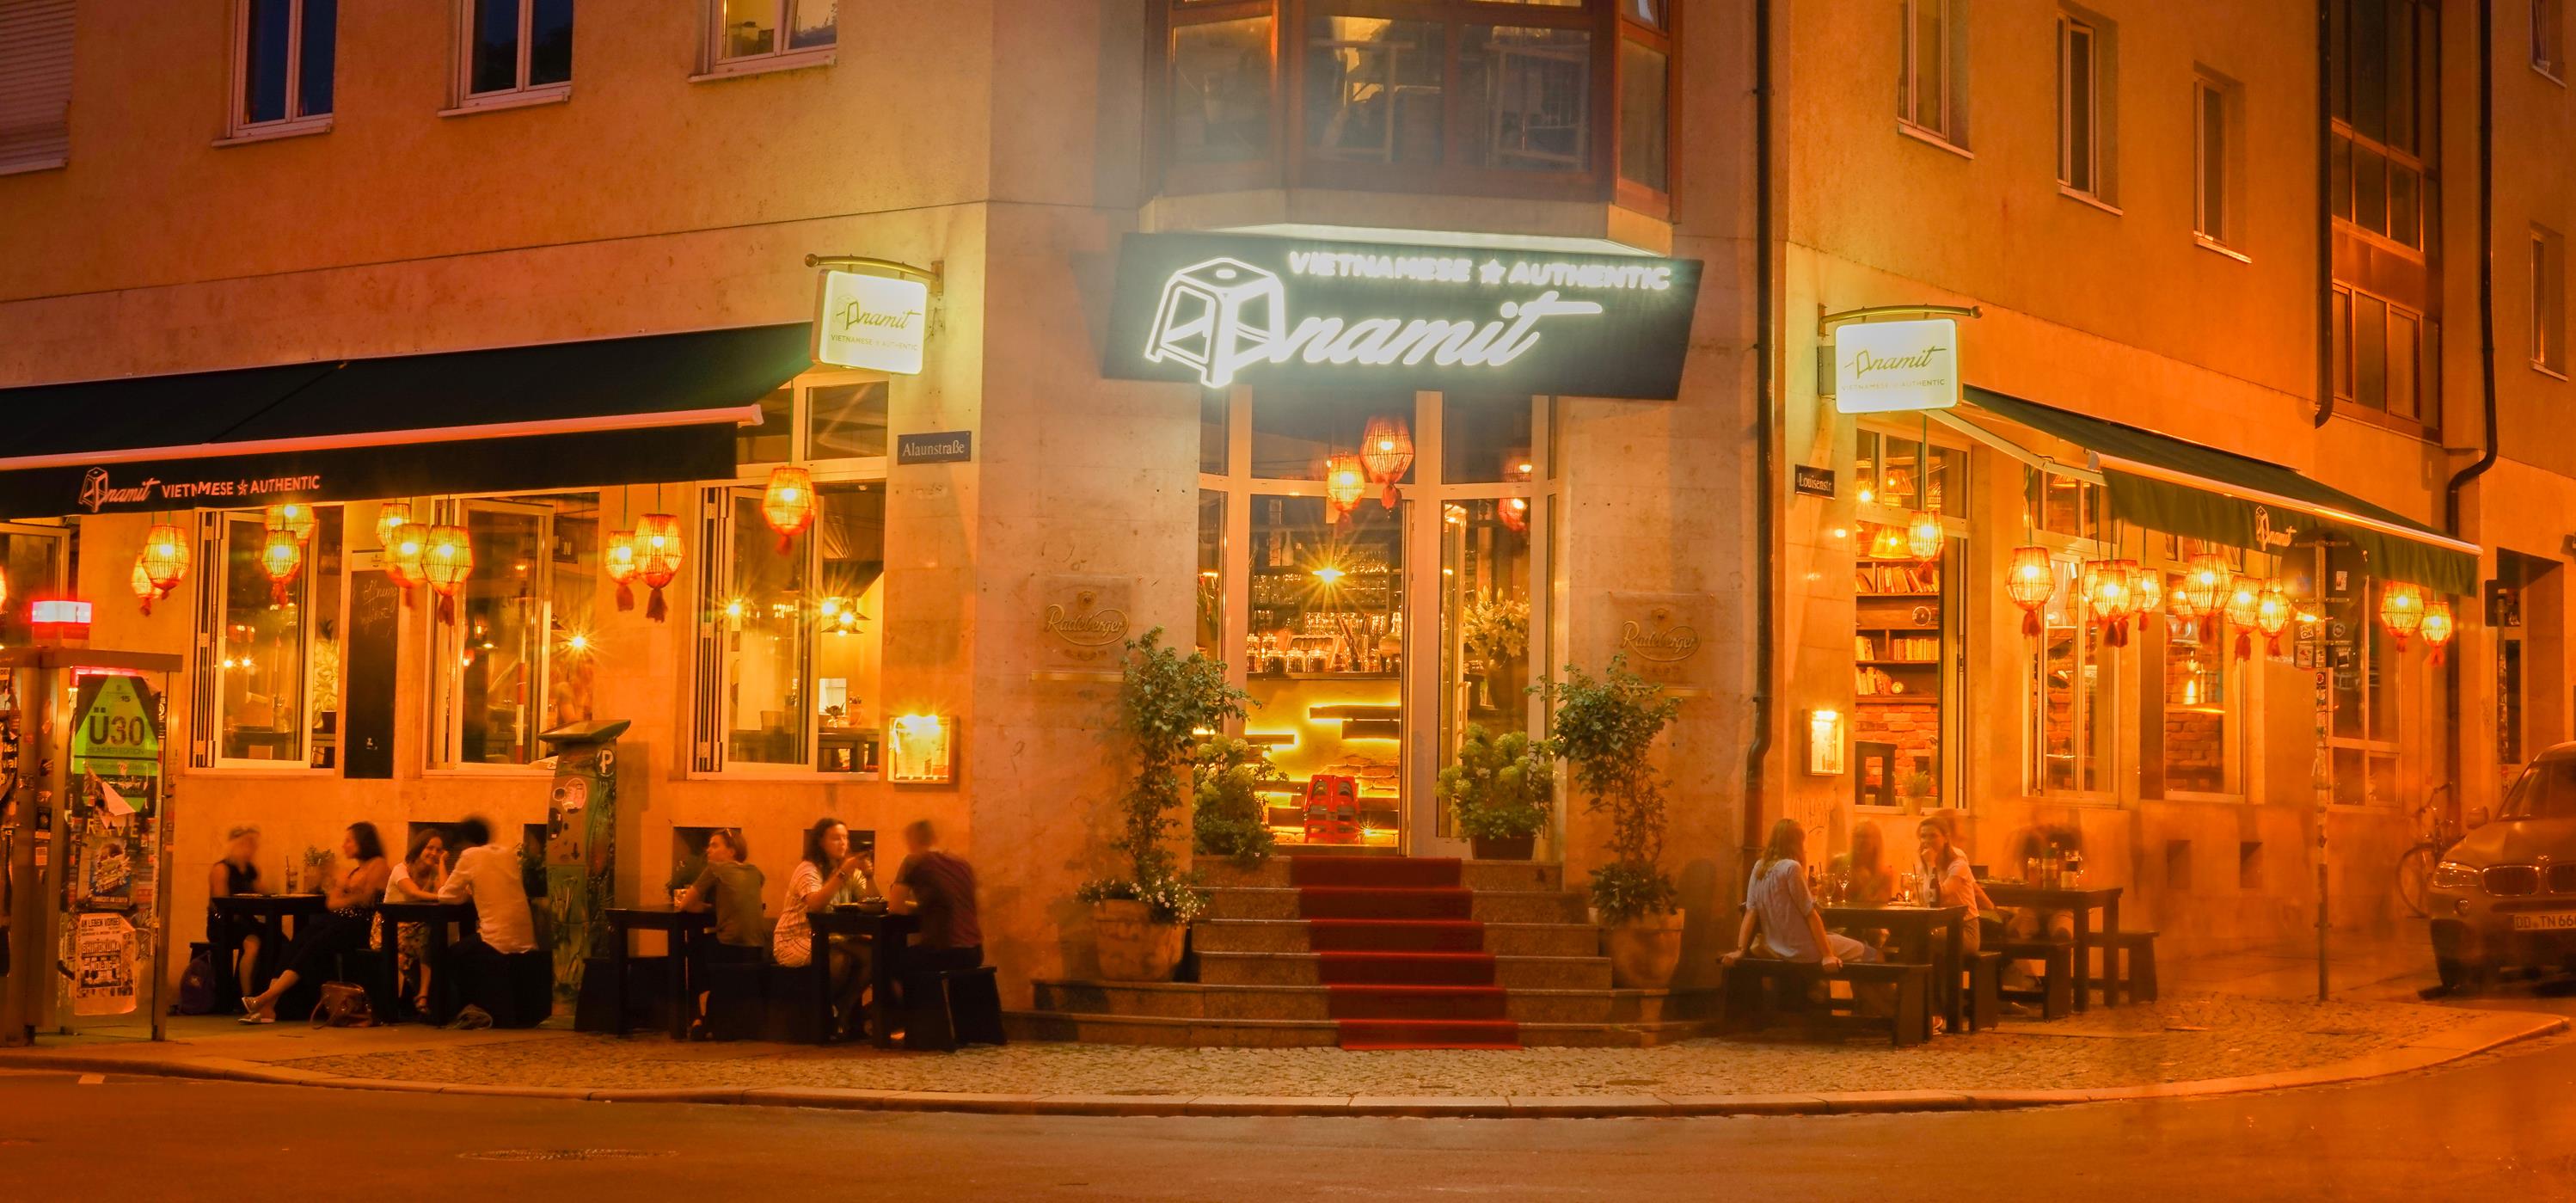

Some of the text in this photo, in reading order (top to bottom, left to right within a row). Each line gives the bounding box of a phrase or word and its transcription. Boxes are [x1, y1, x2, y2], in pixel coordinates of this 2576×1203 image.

[1290, 251, 1671, 290] VIETNAMESE AUTHENTIC
[831, 334, 873, 346] VIETNAMESE
[1843, 346, 1947, 379] Anamit
[1902, 378, 1946, 388] AUTHENTIC
[902, 439, 965, 457] Alaunstraße
[162, 482, 234, 498] VIETNMESE
[249, 475, 321, 494] AUTHENTIC
[1045, 604, 1129, 647] Radeberger
[1621, 620, 1702, 662] Radeberger
[89, 707, 145, 746] Ü30
[2559, 914, 2576, 926] 66
